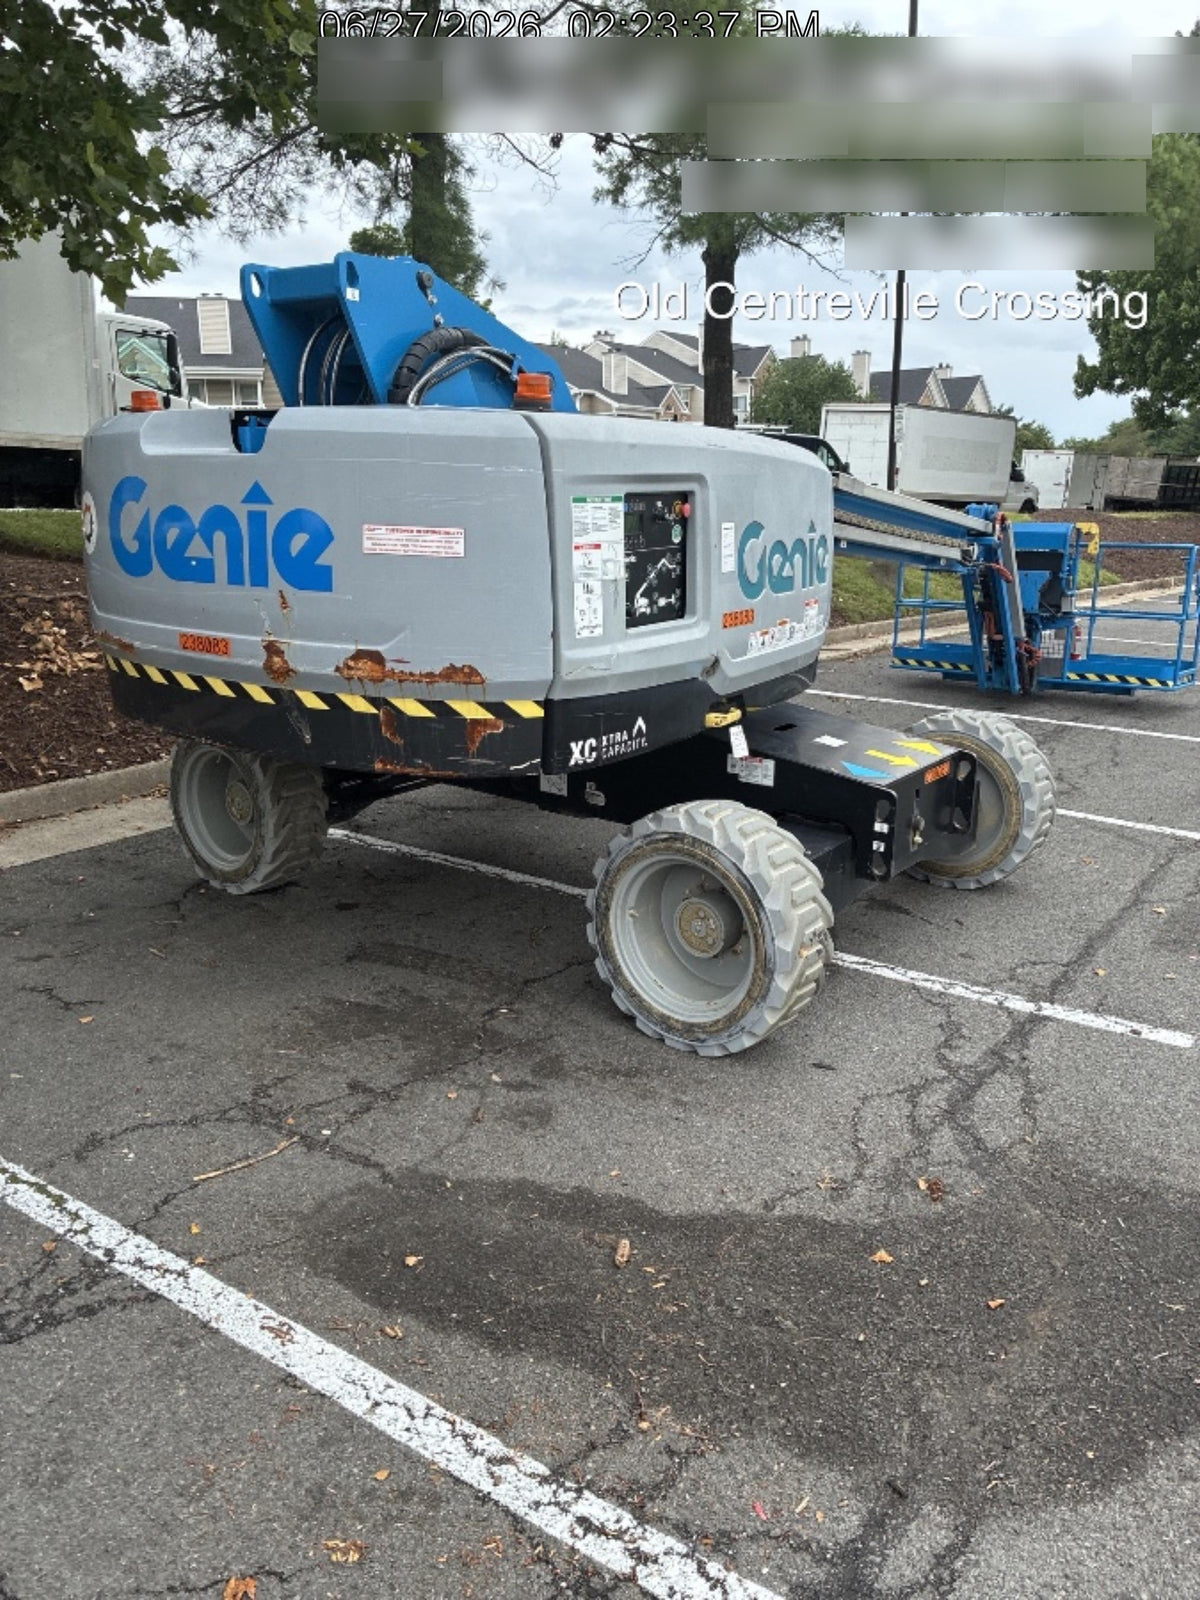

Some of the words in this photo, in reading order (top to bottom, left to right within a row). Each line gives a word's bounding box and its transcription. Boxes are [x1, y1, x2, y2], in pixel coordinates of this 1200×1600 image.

[110, 476, 334, 592] Genie
[738, 520, 829, 600] Genie
[568, 737, 597, 767] XC
[602, 730, 628, 747] XTRA
